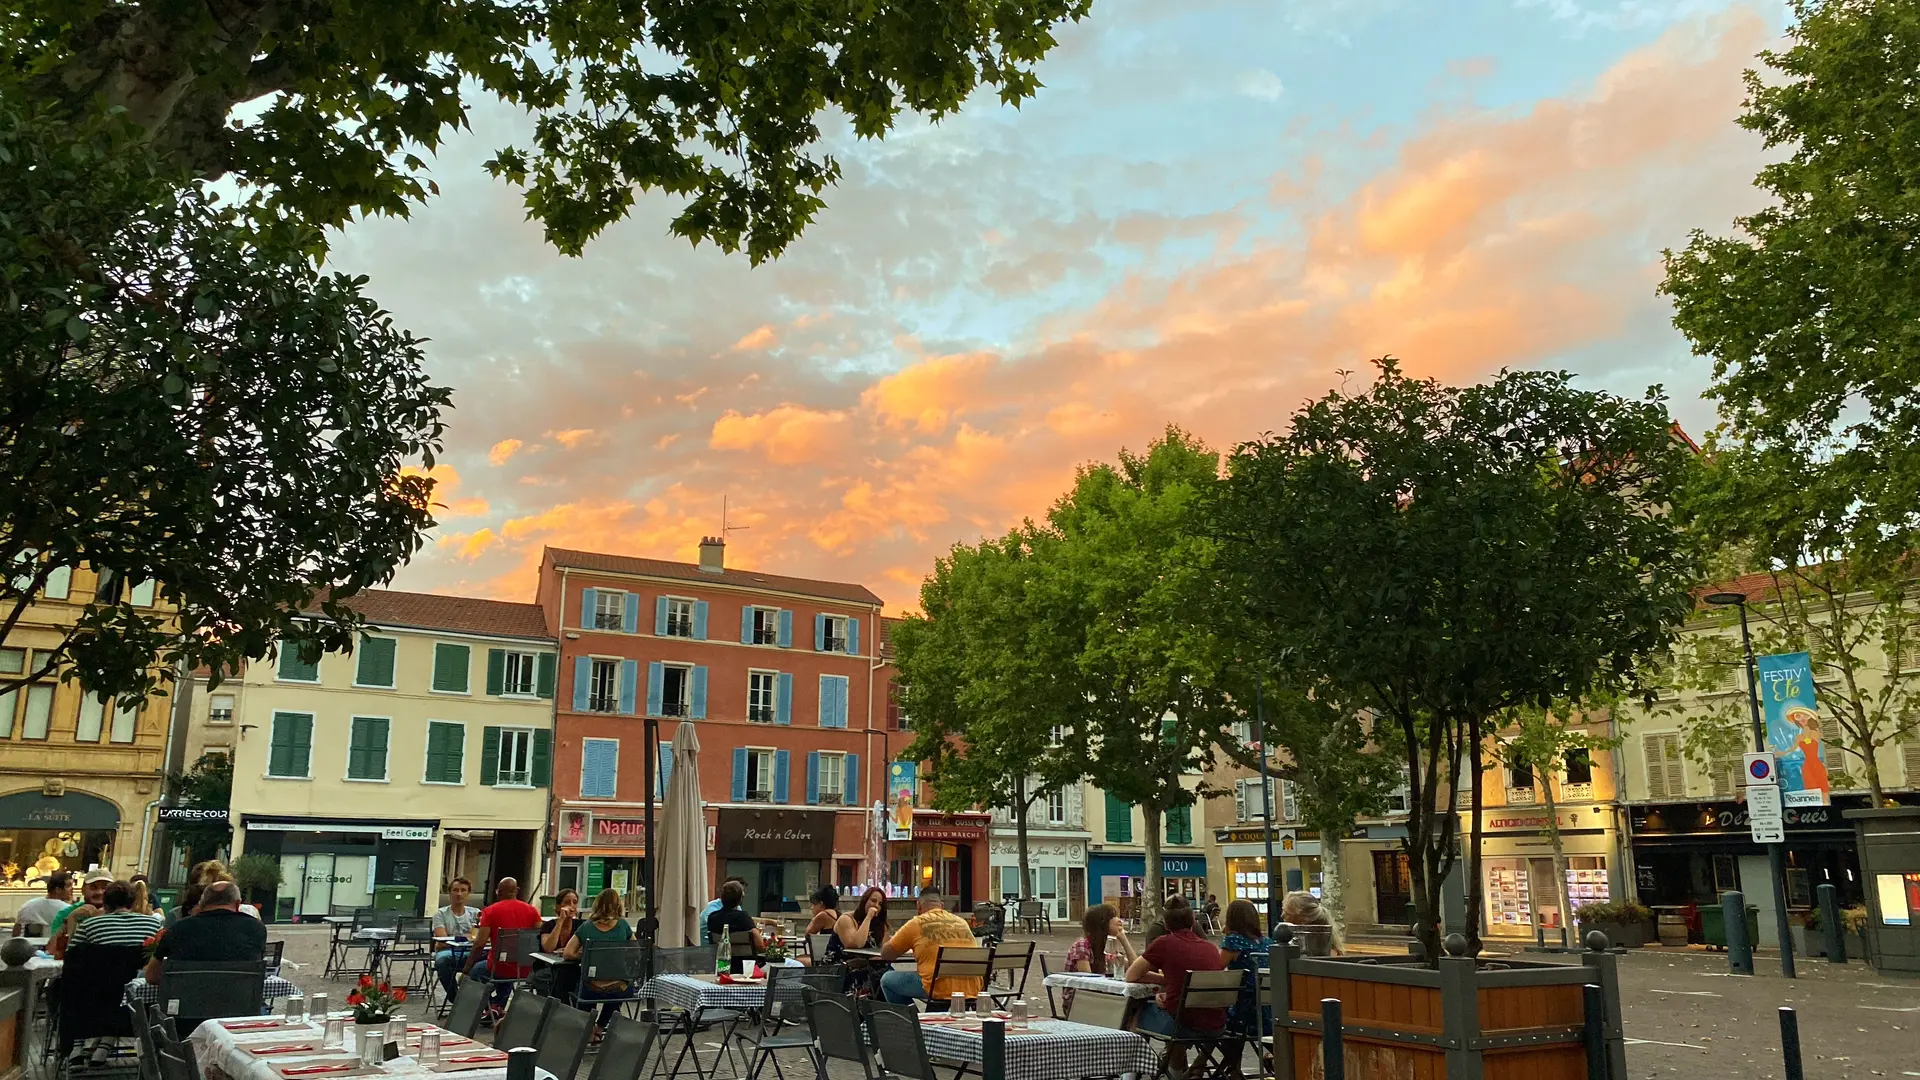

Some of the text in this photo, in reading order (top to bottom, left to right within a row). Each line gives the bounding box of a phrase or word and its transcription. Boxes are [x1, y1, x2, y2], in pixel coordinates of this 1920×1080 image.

[1763, 667, 1806, 682] FESTIV'
[386, 829, 428, 838] Feel Good
[599, 820, 645, 835] Natur
[783, 829, 812, 840] Color
[1163, 860, 1189, 872] 1020
